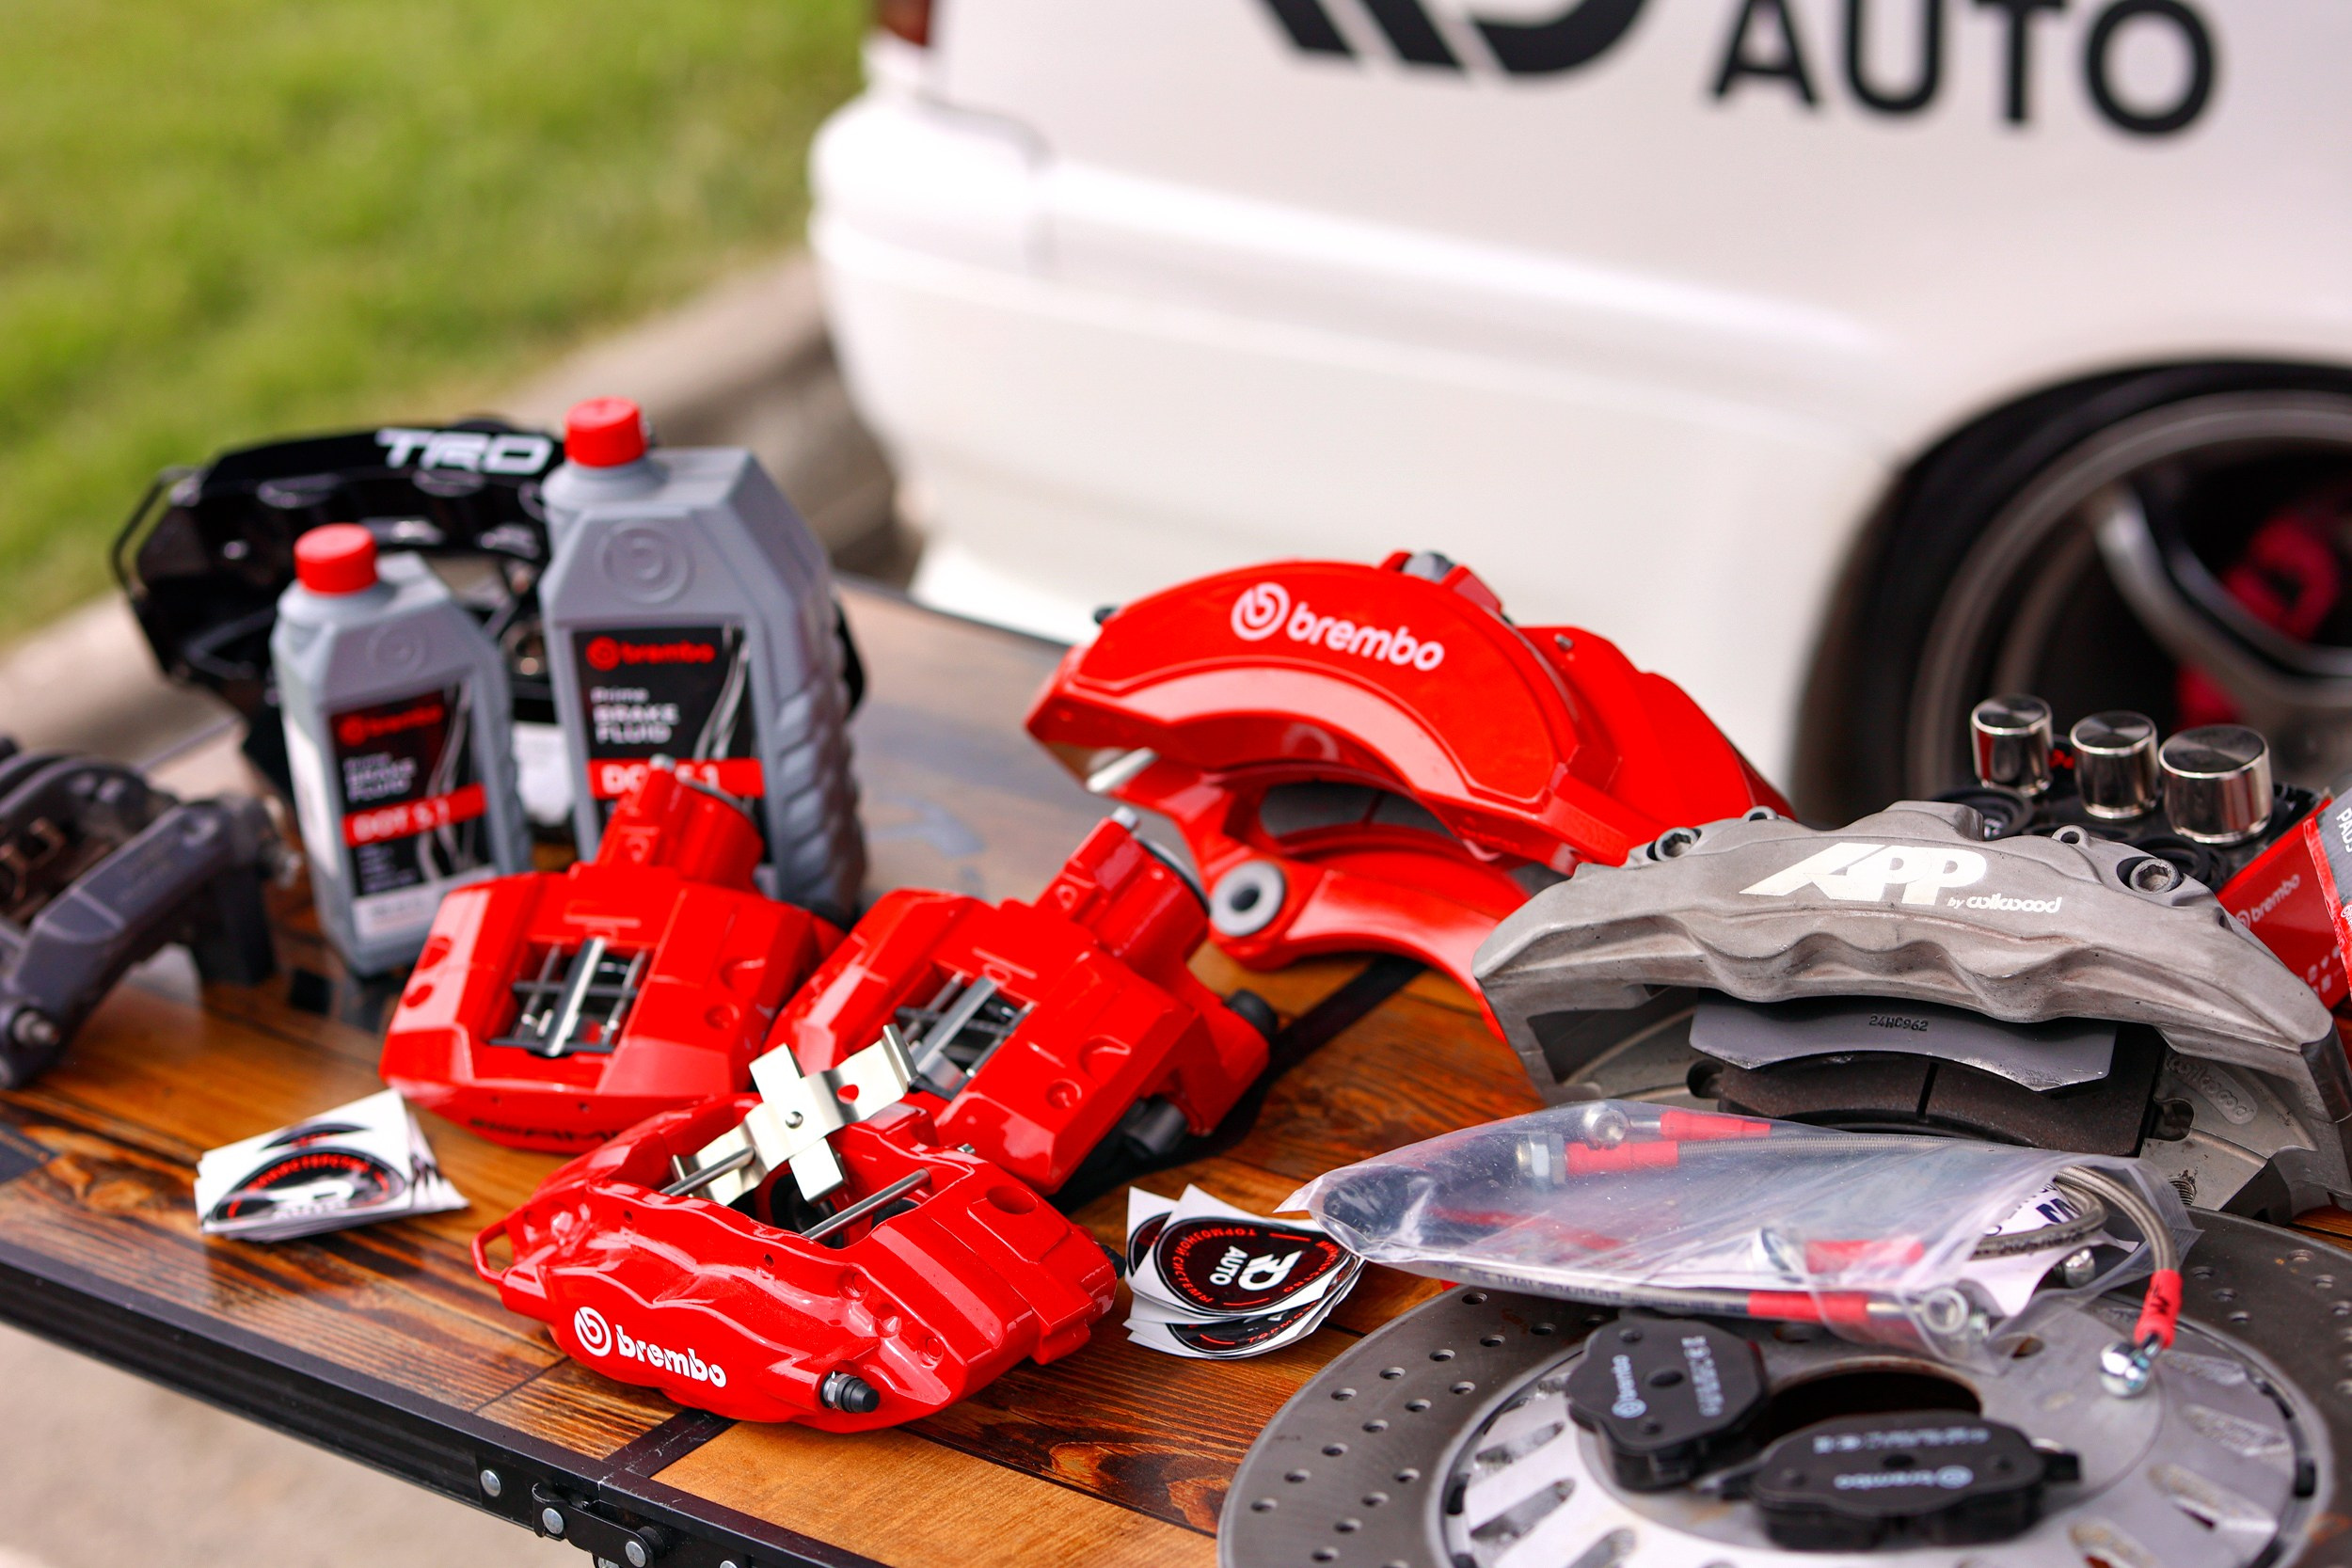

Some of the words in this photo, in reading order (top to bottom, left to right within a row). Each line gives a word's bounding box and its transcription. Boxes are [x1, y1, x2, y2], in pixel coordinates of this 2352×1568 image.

[1712, 0, 2217, 140] AUTO
[375, 428, 553, 474] TRD
[1286, 601, 1445, 672] brembo
[1947, 896, 1965, 909] by
[2249, 874, 2300, 924] brembo
[1175, 1227, 1257, 1257] ТОРМОЗНОЙ
[1209, 1244, 1249, 1286] AUTO
[1172, 1256, 1215, 1304] СИСТЕМЫ
[615, 1323, 727, 1388] brembo
